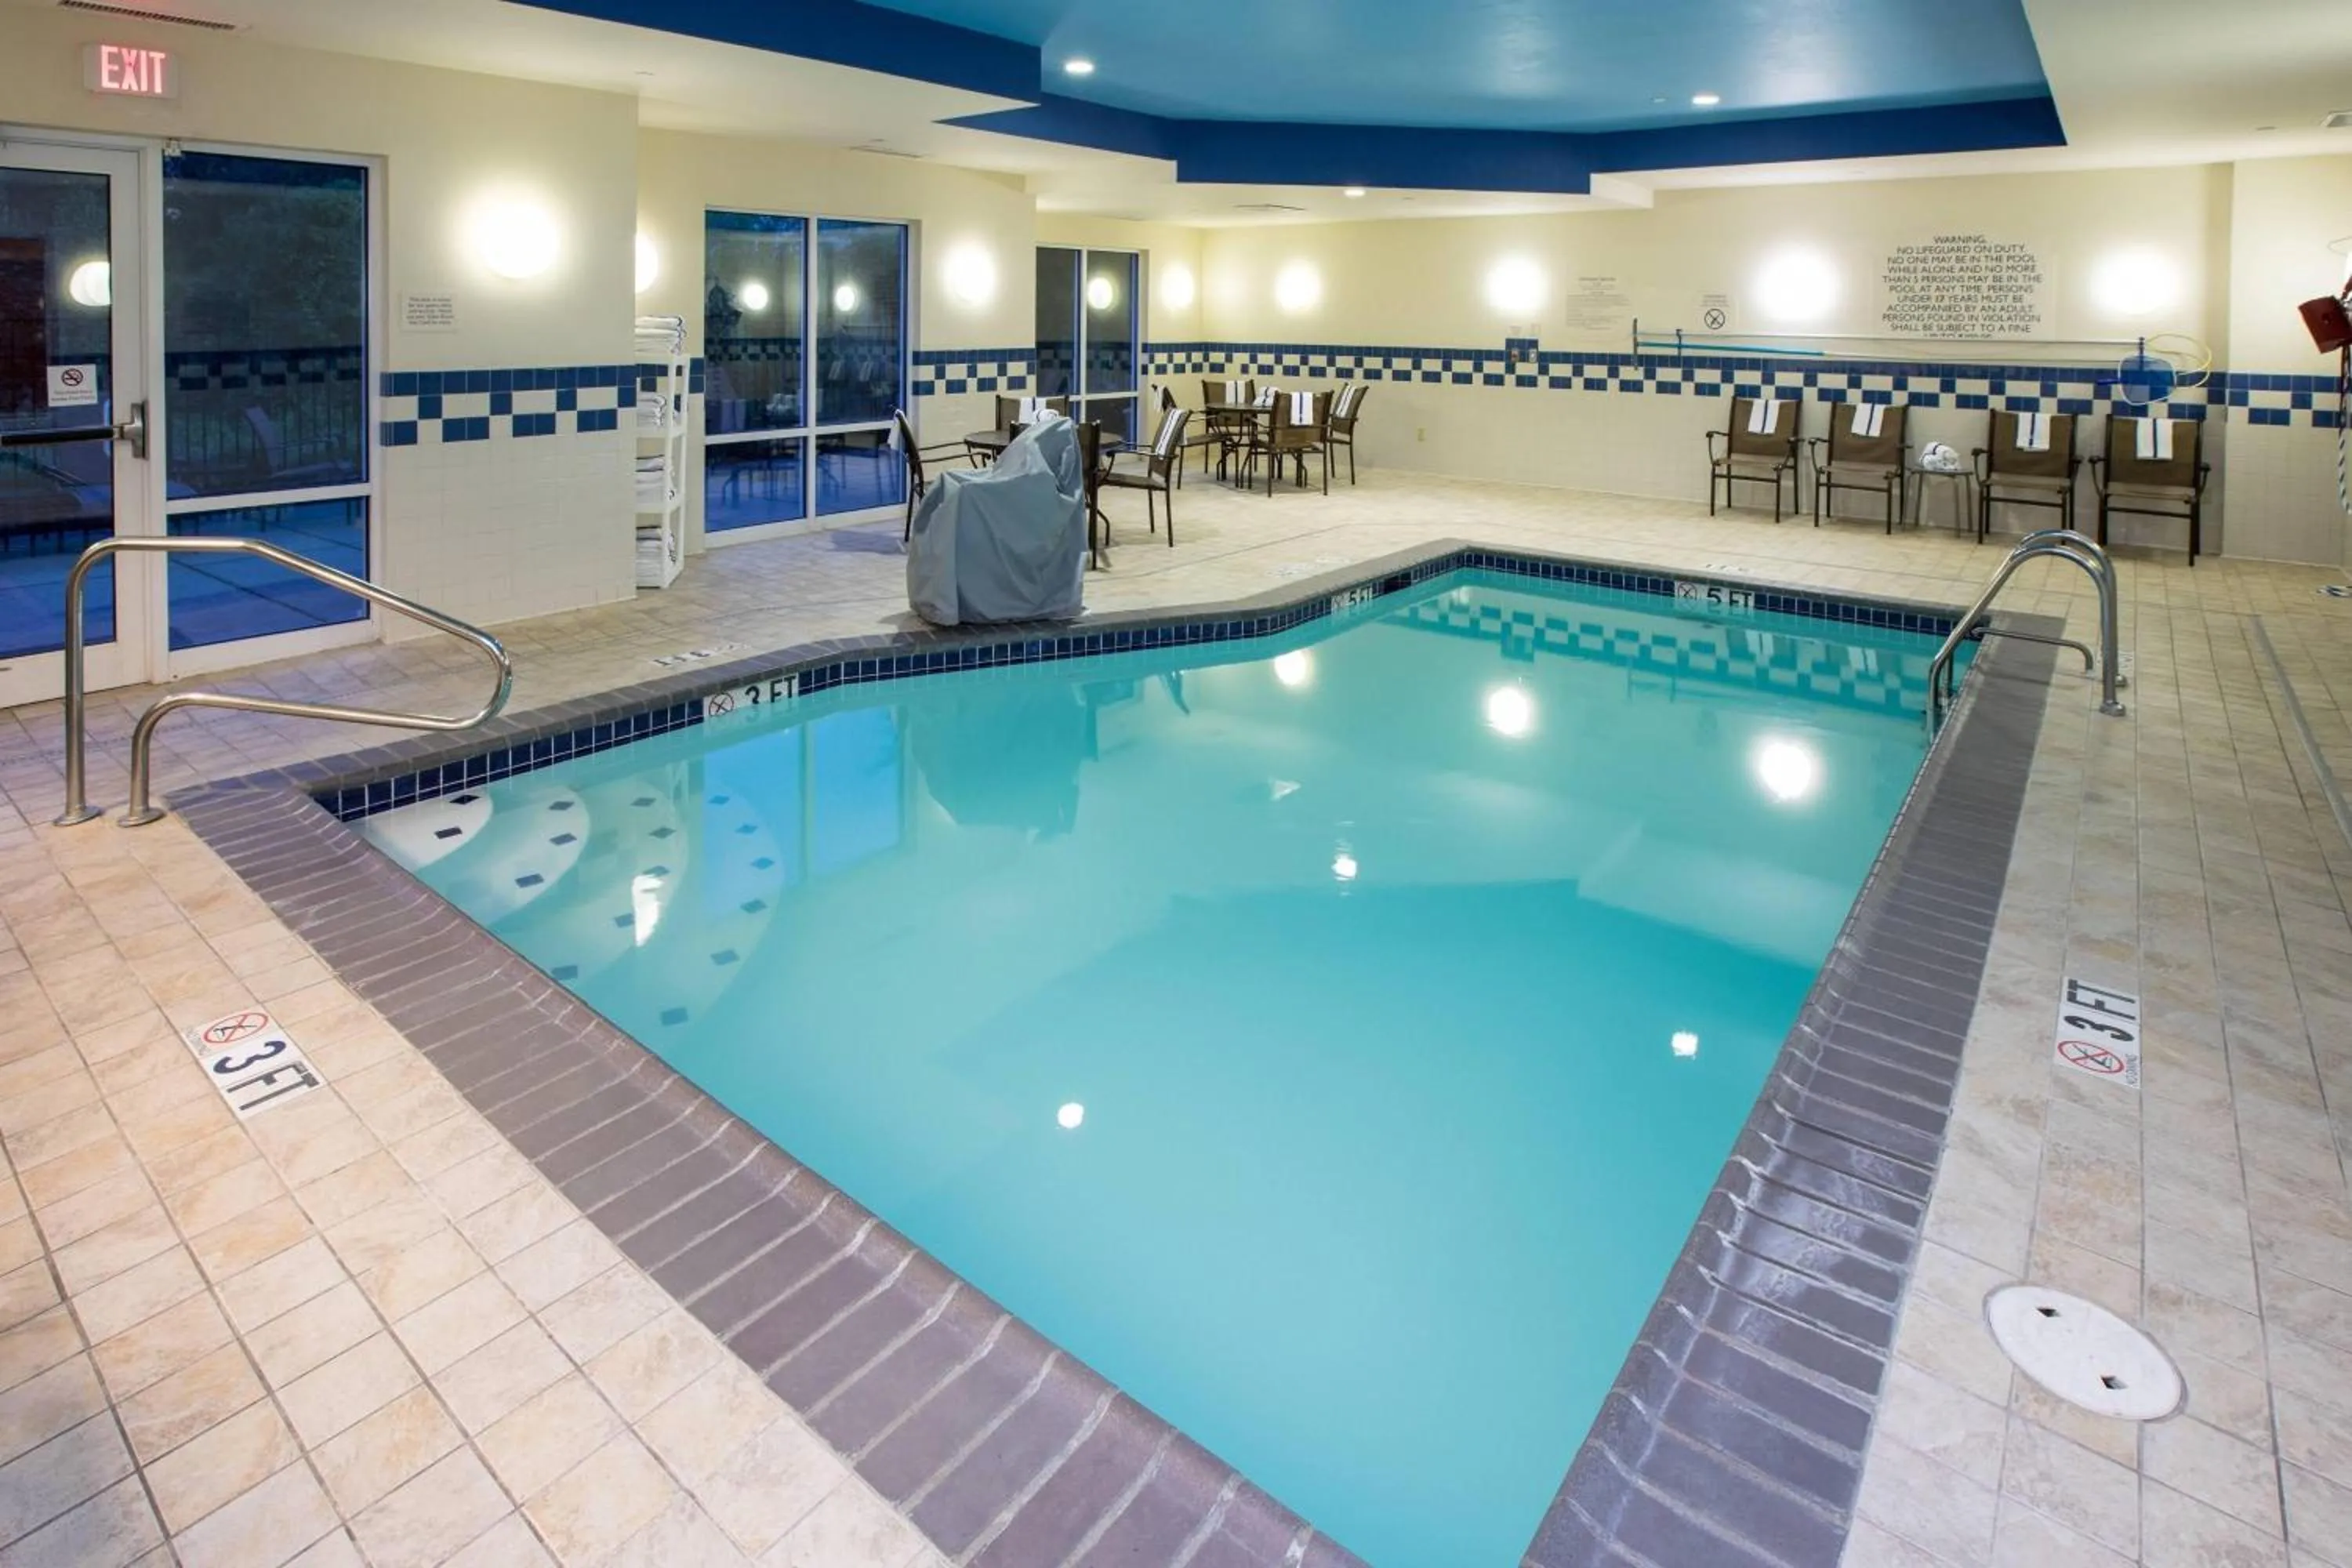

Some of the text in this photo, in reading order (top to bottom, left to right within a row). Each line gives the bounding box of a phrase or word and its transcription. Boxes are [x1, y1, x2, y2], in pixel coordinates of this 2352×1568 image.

[102, 45, 165, 93] EXIT
[1896, 246, 1913, 255] NO
[1916, 245, 1971, 255] LIFEGUARD
[1973, 245, 1992, 254] ON
[1907, 256, 1929, 264] ONE
[1931, 256, 1953, 264] MAY
[1955, 255, 1969, 263] BE
[1969, 255, 1981, 263] IN
[1985, 255, 2003, 263] THE
[1922, 265, 1957, 274] ALONE
[1958, 265, 1983, 274] AND
[2007, 274, 2019, 283] IN
[2022, 274, 2042, 282] THE
[1935, 285, 1956, 293] ANY
[1987, 285, 2034, 293] PERSONS
[1886, 304, 1962, 313] ACCOMPANIED
[1882, 314, 1925, 322] PERSONS
[1927, 314, 1964, 322] FOUND
[1981, 314, 2041, 322] VIOLATION
[1891, 323, 1920, 332] SHALL
[1936, 324, 1976, 332] SUBJECT
[1980, 324, 1995, 332] TO
[1998, 324, 2005, 332] A
[2008, 324, 2031, 332] FINE
[1730, 590, 1751, 608] FT
[771, 675, 795, 703] FT
[2064, 978, 2136, 1042] 3 FT
[212, 1040, 320, 1111] 3 FT
